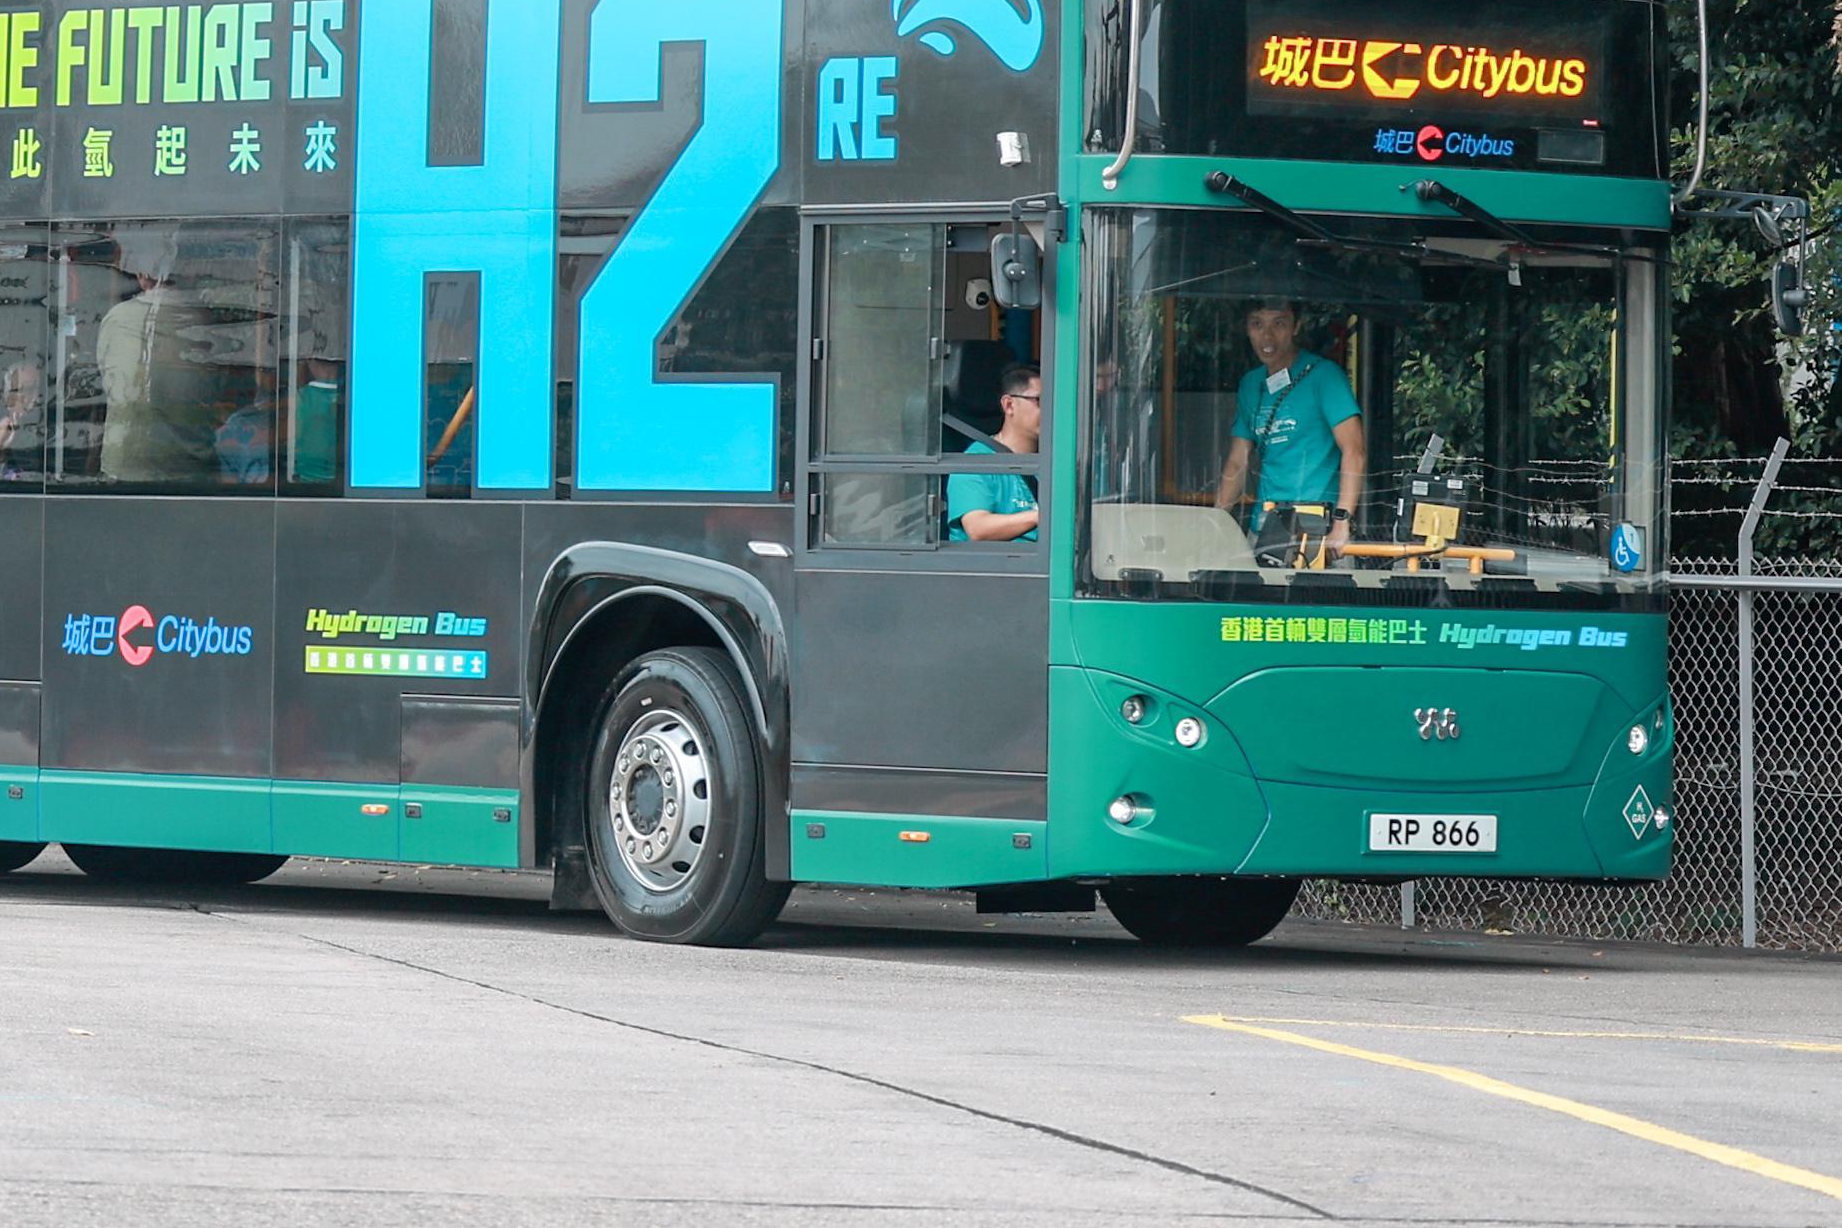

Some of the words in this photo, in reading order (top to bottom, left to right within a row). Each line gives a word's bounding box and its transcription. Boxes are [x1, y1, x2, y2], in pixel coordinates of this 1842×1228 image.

[56, 2, 274, 106] FUTURE
[817, 56, 899, 161] RE
[1259, 35, 1358, 90] 城巴
[1426, 44, 1587, 98] Citybus
[1373, 128, 1414, 154] 城巴
[1445, 132, 1514, 157] Citybus
[62, 613, 115, 655] 城巴
[157, 614, 253, 658] Citybus
[306, 609, 429, 640] Hydrogen
[434, 612, 487, 636] Bus
[1439, 623, 1572, 650] Hydrogen
[1578, 626, 1628, 647] Bus
[1388, 819, 1420, 845] RP
[1432, 820, 1480, 847] 866
